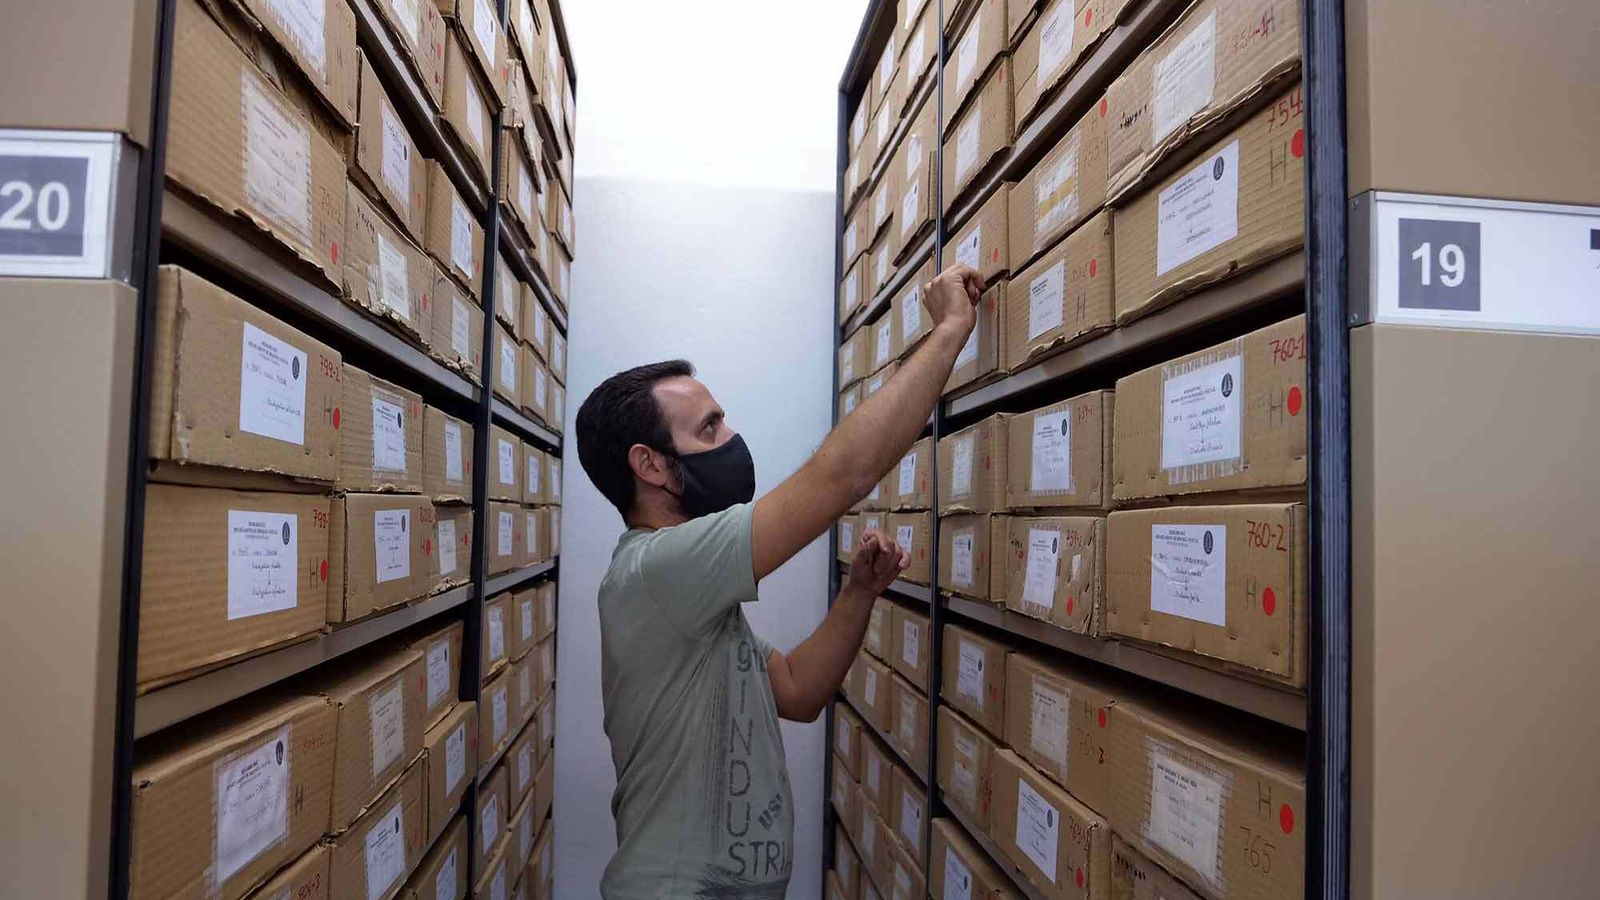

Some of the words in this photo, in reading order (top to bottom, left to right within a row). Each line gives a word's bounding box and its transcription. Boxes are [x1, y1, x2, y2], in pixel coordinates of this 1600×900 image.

[1267, 90, 1304, 132] 754
[1270, 141, 1287, 187] H
[0, 181, 70, 231] 20
[1411, 242, 1466, 288] 19
[1268, 334, 1305, 367] 760-1
[1269, 389, 1283, 427] H
[1246, 519, 1288, 552] 760-2
[309, 556, 319, 589] H
[1246, 577, 1257, 609] H
[1257, 781, 1273, 820] H
[1239, 825, 1278, 874] 765
